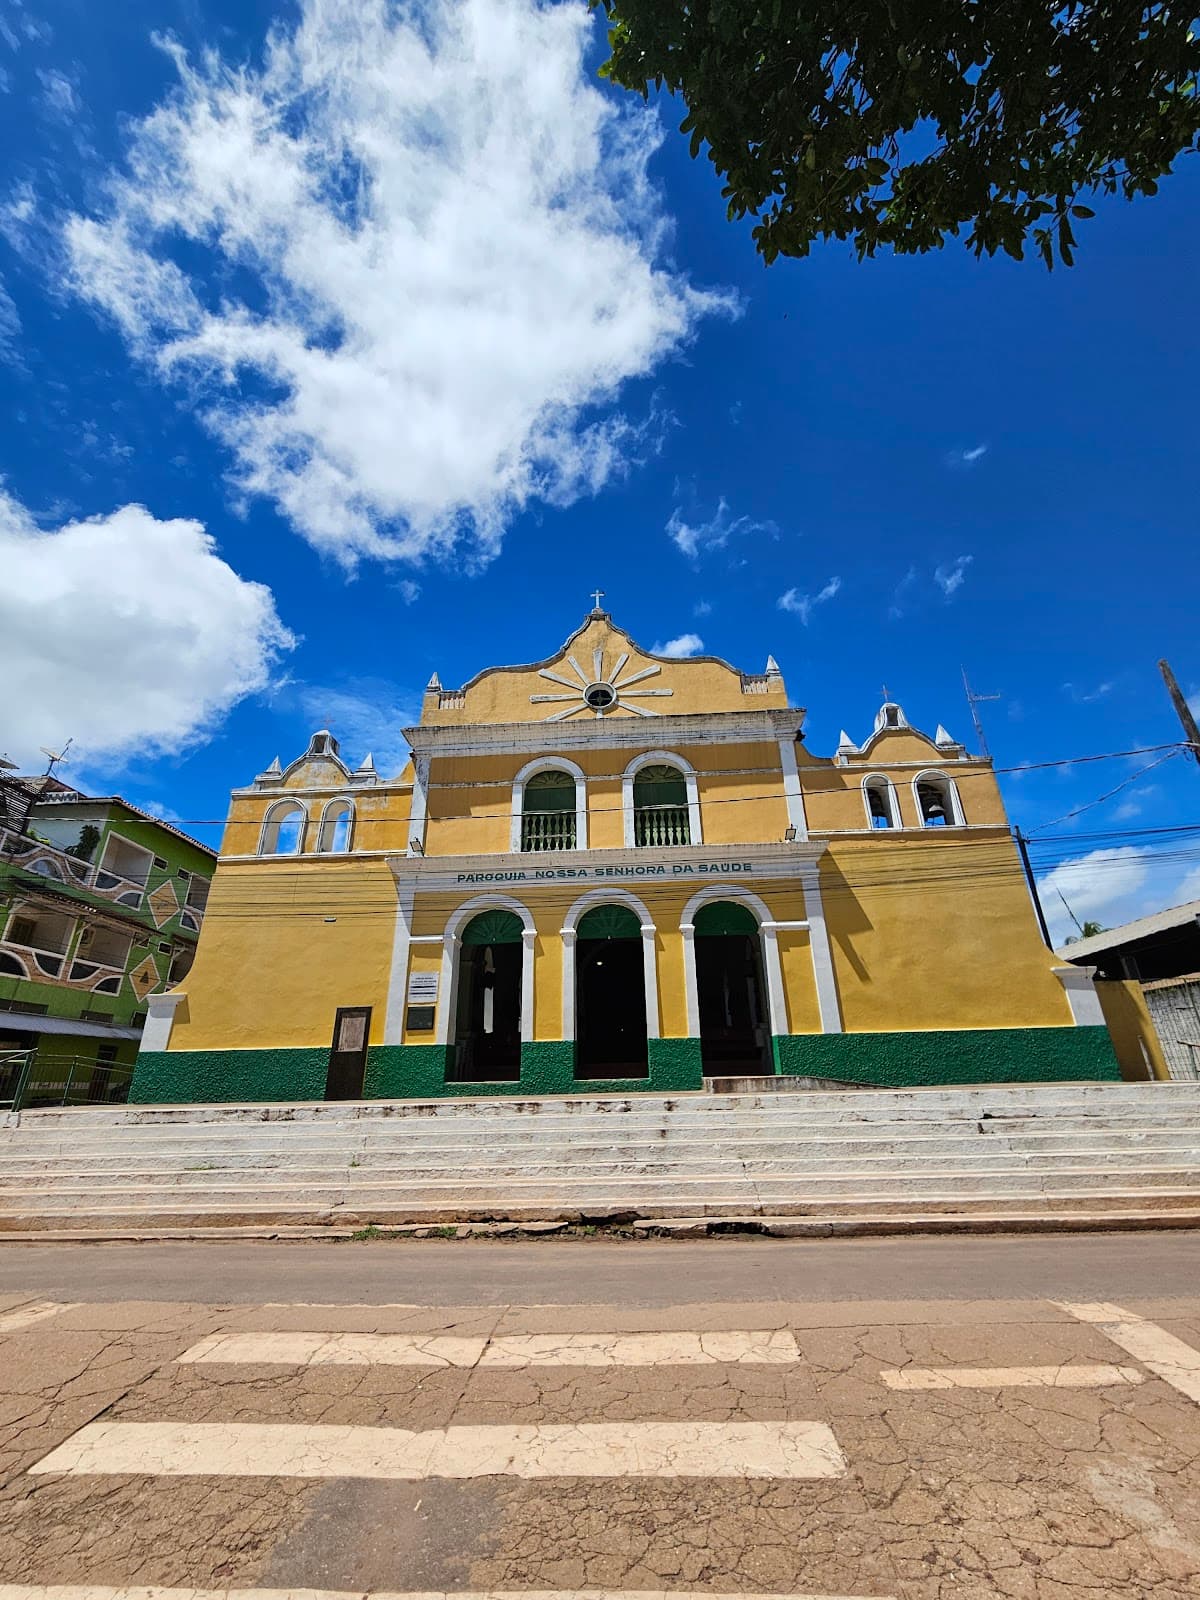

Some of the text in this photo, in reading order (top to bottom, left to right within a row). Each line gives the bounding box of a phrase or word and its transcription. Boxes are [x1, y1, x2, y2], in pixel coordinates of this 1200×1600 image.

[457, 871, 526, 883] PAROQUIA
[535, 869, 588, 879] NOSSA
[594, 866, 666, 877] SENHORA
[672, 864, 694, 874] DA
